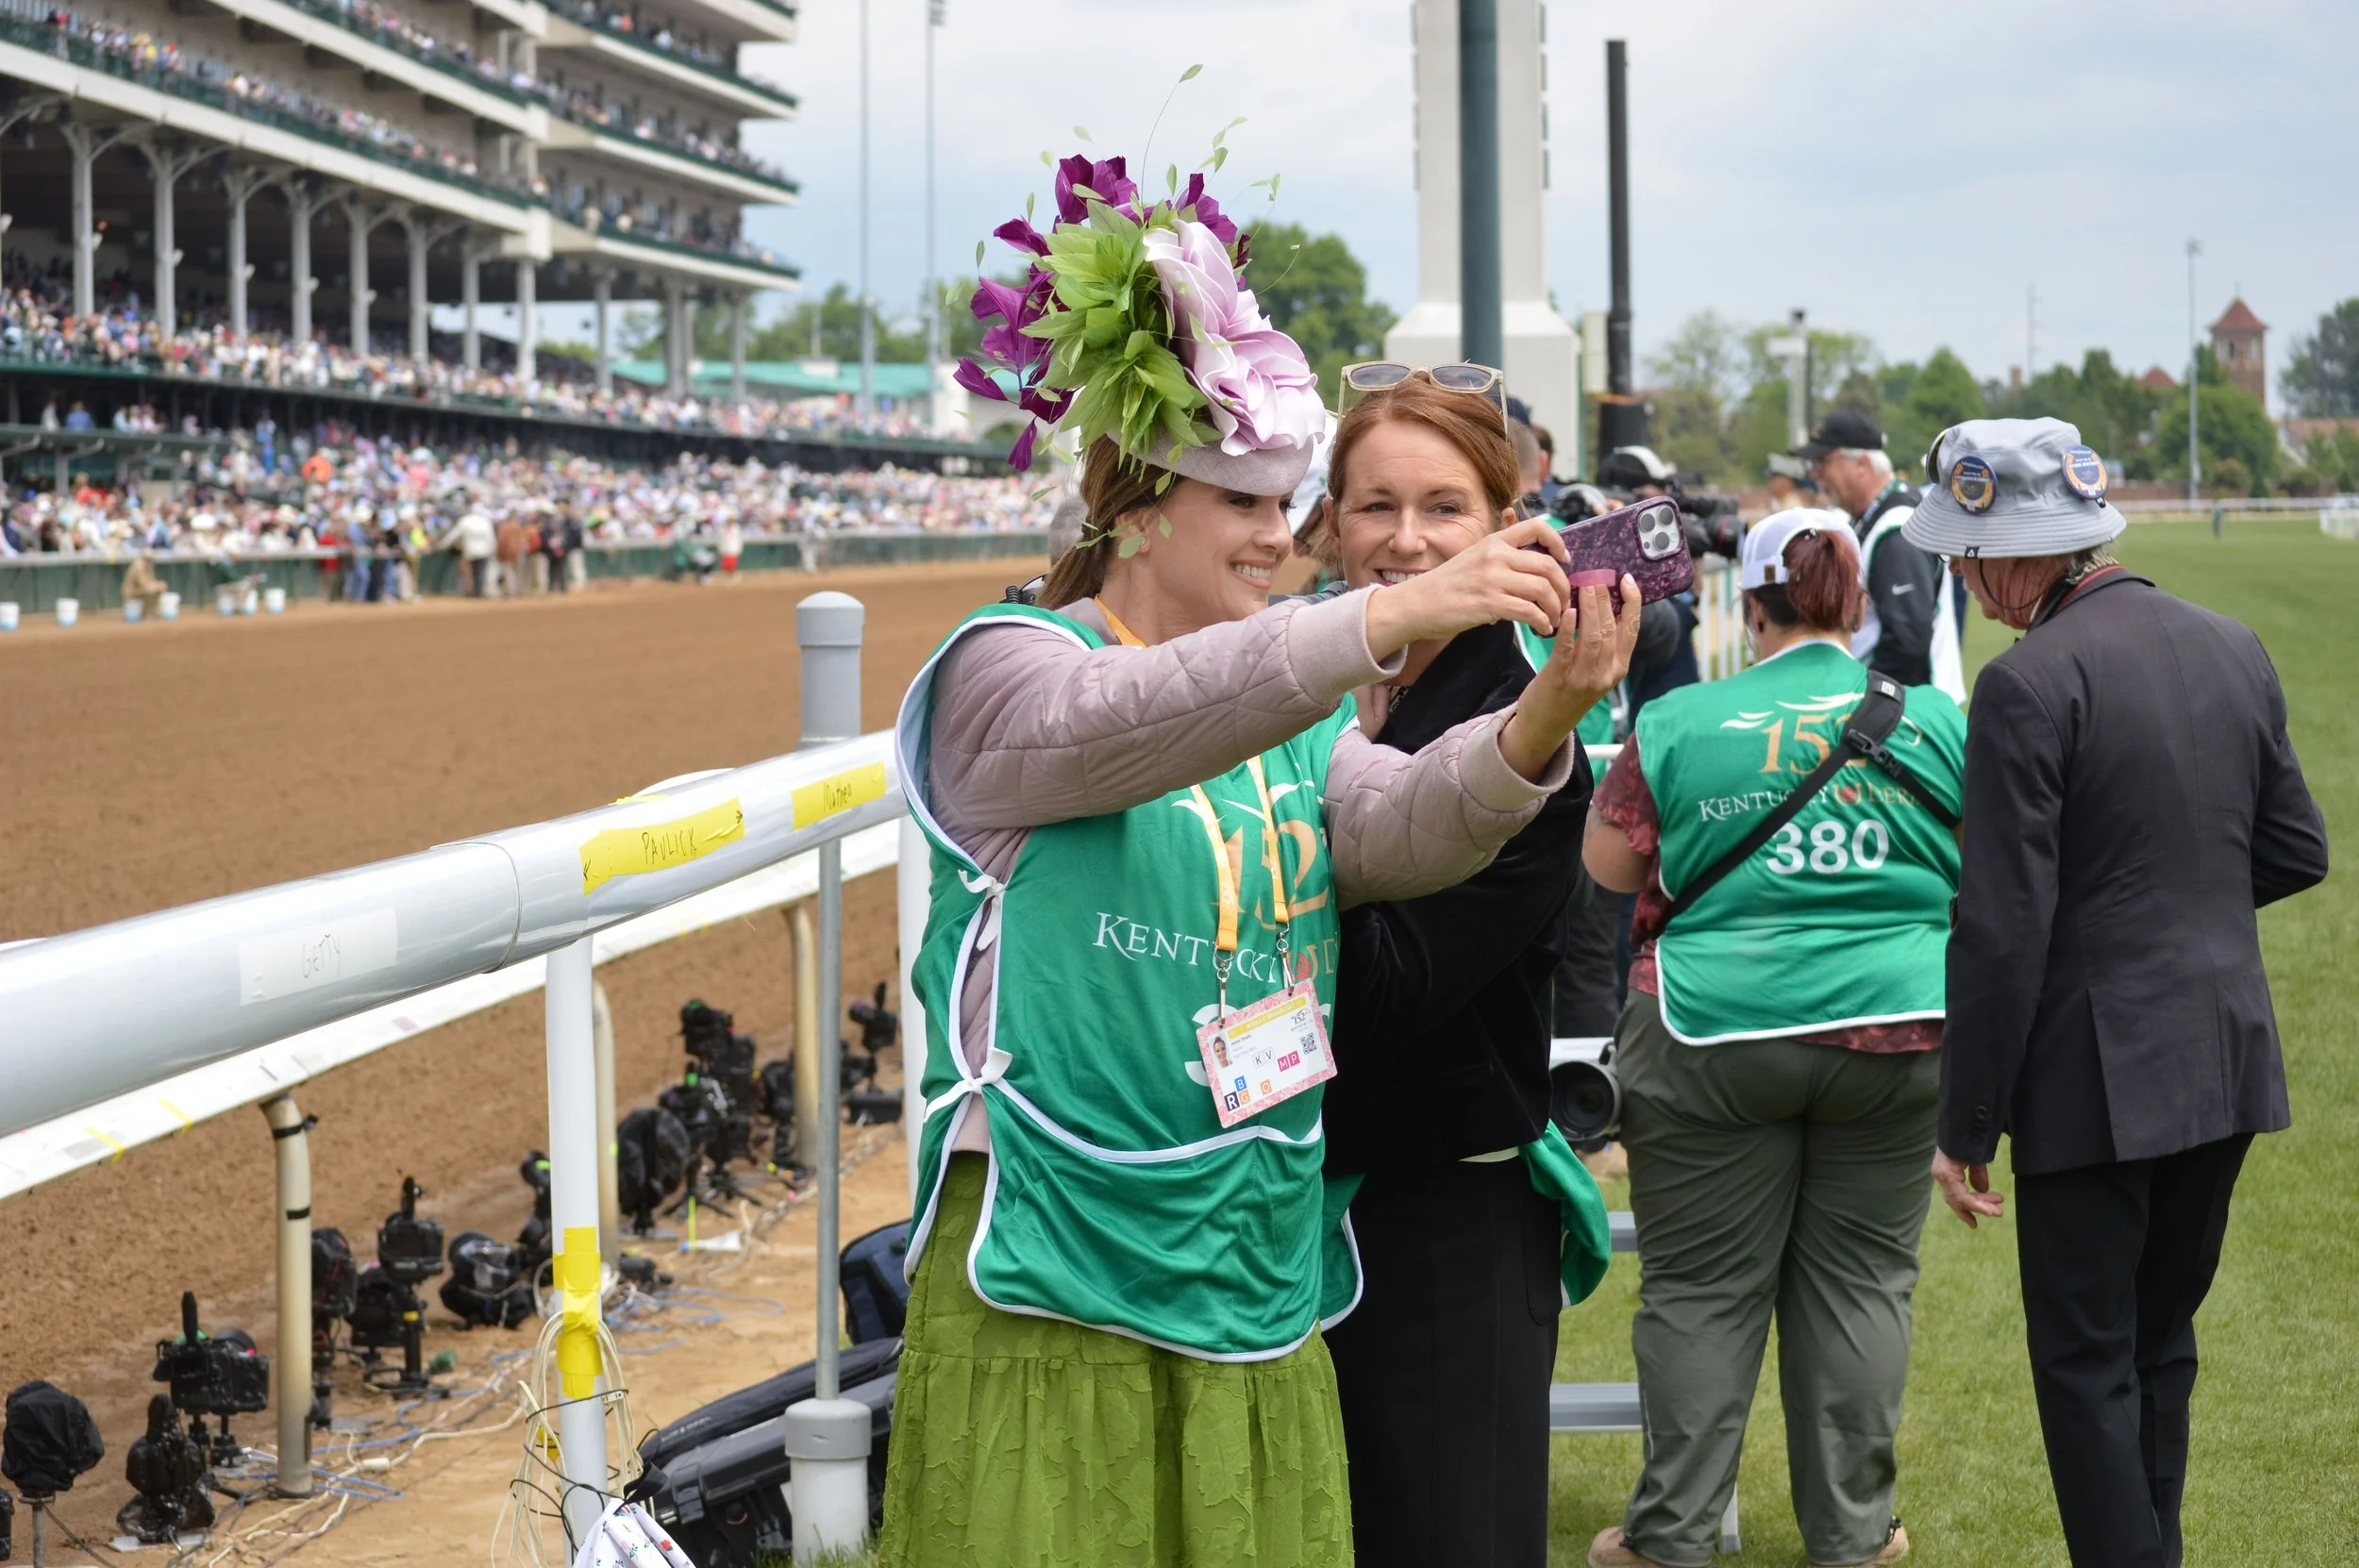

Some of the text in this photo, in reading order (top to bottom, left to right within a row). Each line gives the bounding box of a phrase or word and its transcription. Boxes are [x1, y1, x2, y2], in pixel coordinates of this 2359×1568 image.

[1759, 713, 1866, 775] 15
[1698, 786, 1829, 823] KENTUY
[1765, 819, 1890, 875] 380
[1255, 1055, 1263, 1065] K
[1265, 1050, 1273, 1060] V
[1279, 1053, 1297, 1071] M P
[1237, 1078, 1245, 1089] B
[1227, 1093, 1248, 1110] R G
